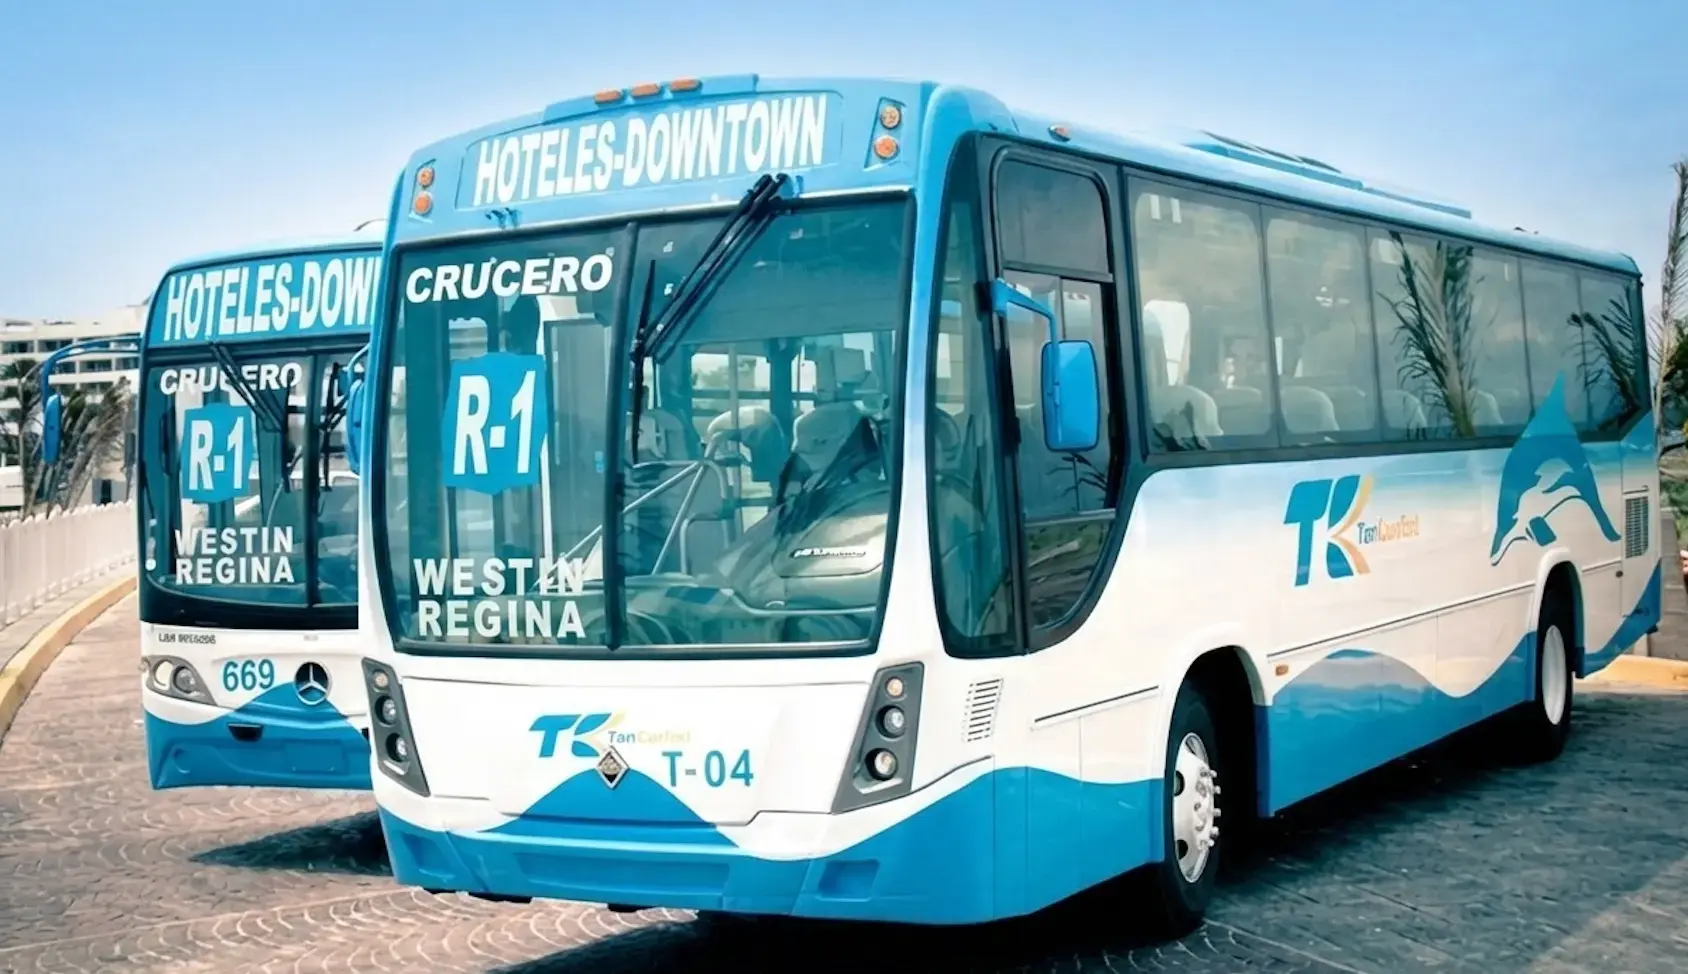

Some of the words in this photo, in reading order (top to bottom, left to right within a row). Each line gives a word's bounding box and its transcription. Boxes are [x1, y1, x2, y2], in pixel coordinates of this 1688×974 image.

[474, 95, 826, 205] HOTELES-DOWNTOWN
[406, 253, 614, 304] CRUCERO
[453, 370, 537, 475] R-1
[188, 415, 245, 491] R-1
[174, 526, 294, 556] WESTIN
[175, 556, 295, 585] REGINA
[414, 557, 585, 597] WESTIN
[417, 600, 586, 639] REGINA
[222, 658, 276, 692] 669
[661, 749, 755, 787] T-04
